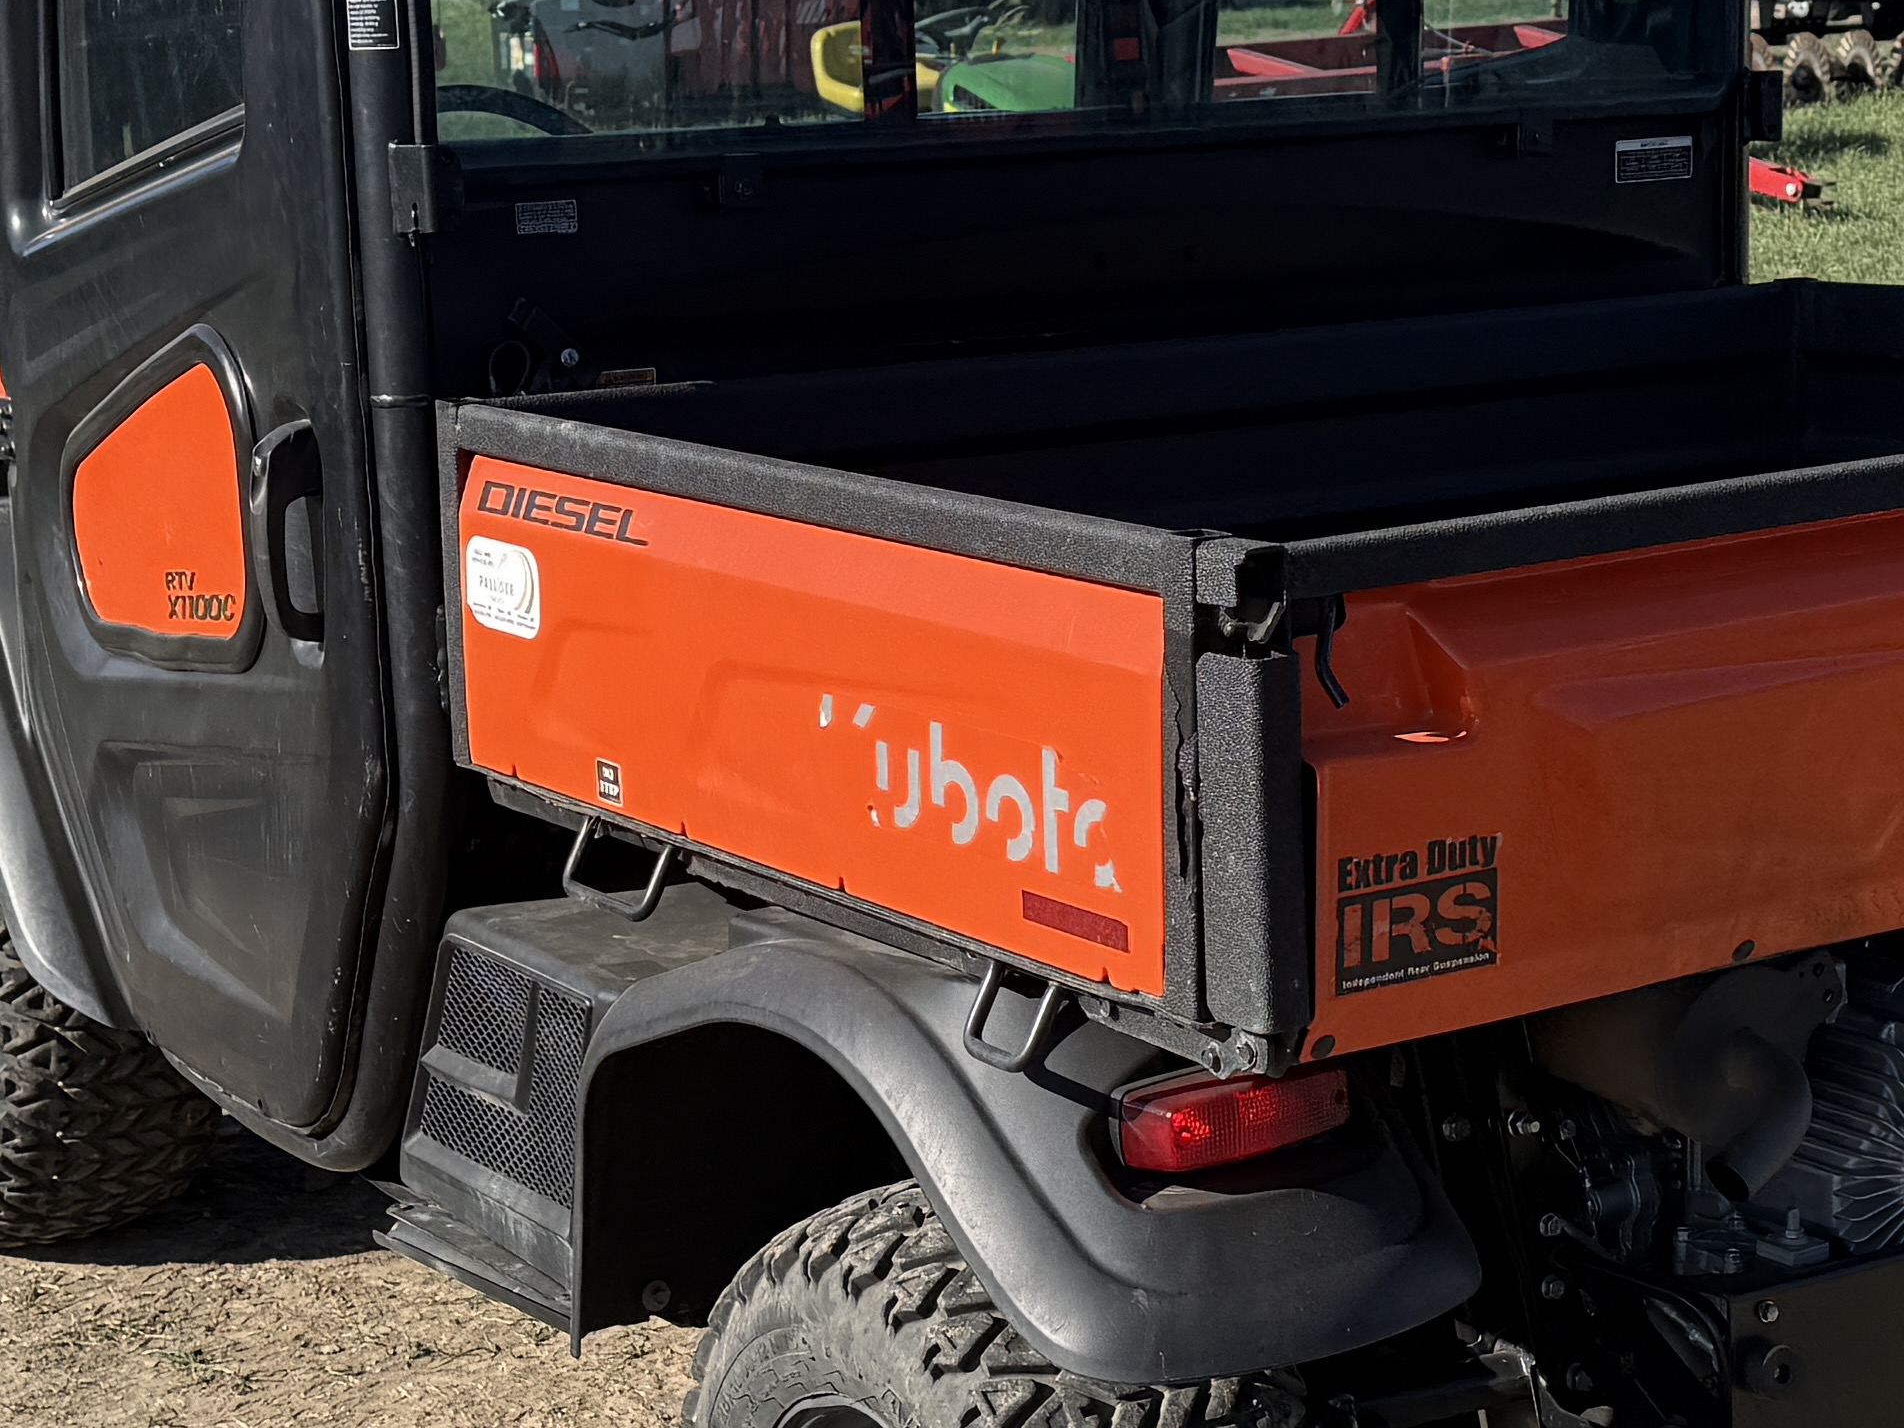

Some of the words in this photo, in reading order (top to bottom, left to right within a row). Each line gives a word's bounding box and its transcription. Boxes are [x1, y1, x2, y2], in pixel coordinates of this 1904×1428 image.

[477, 480, 650, 547] DIESEL
[164, 570, 197, 591] RTV
[167, 593, 237, 622] X1100C
[818, 692, 1123, 893] ubot
[1337, 849, 1419, 893] Extra
[1426, 834, 1499, 876] Duty
[1343, 881, 1493, 969] IRS
